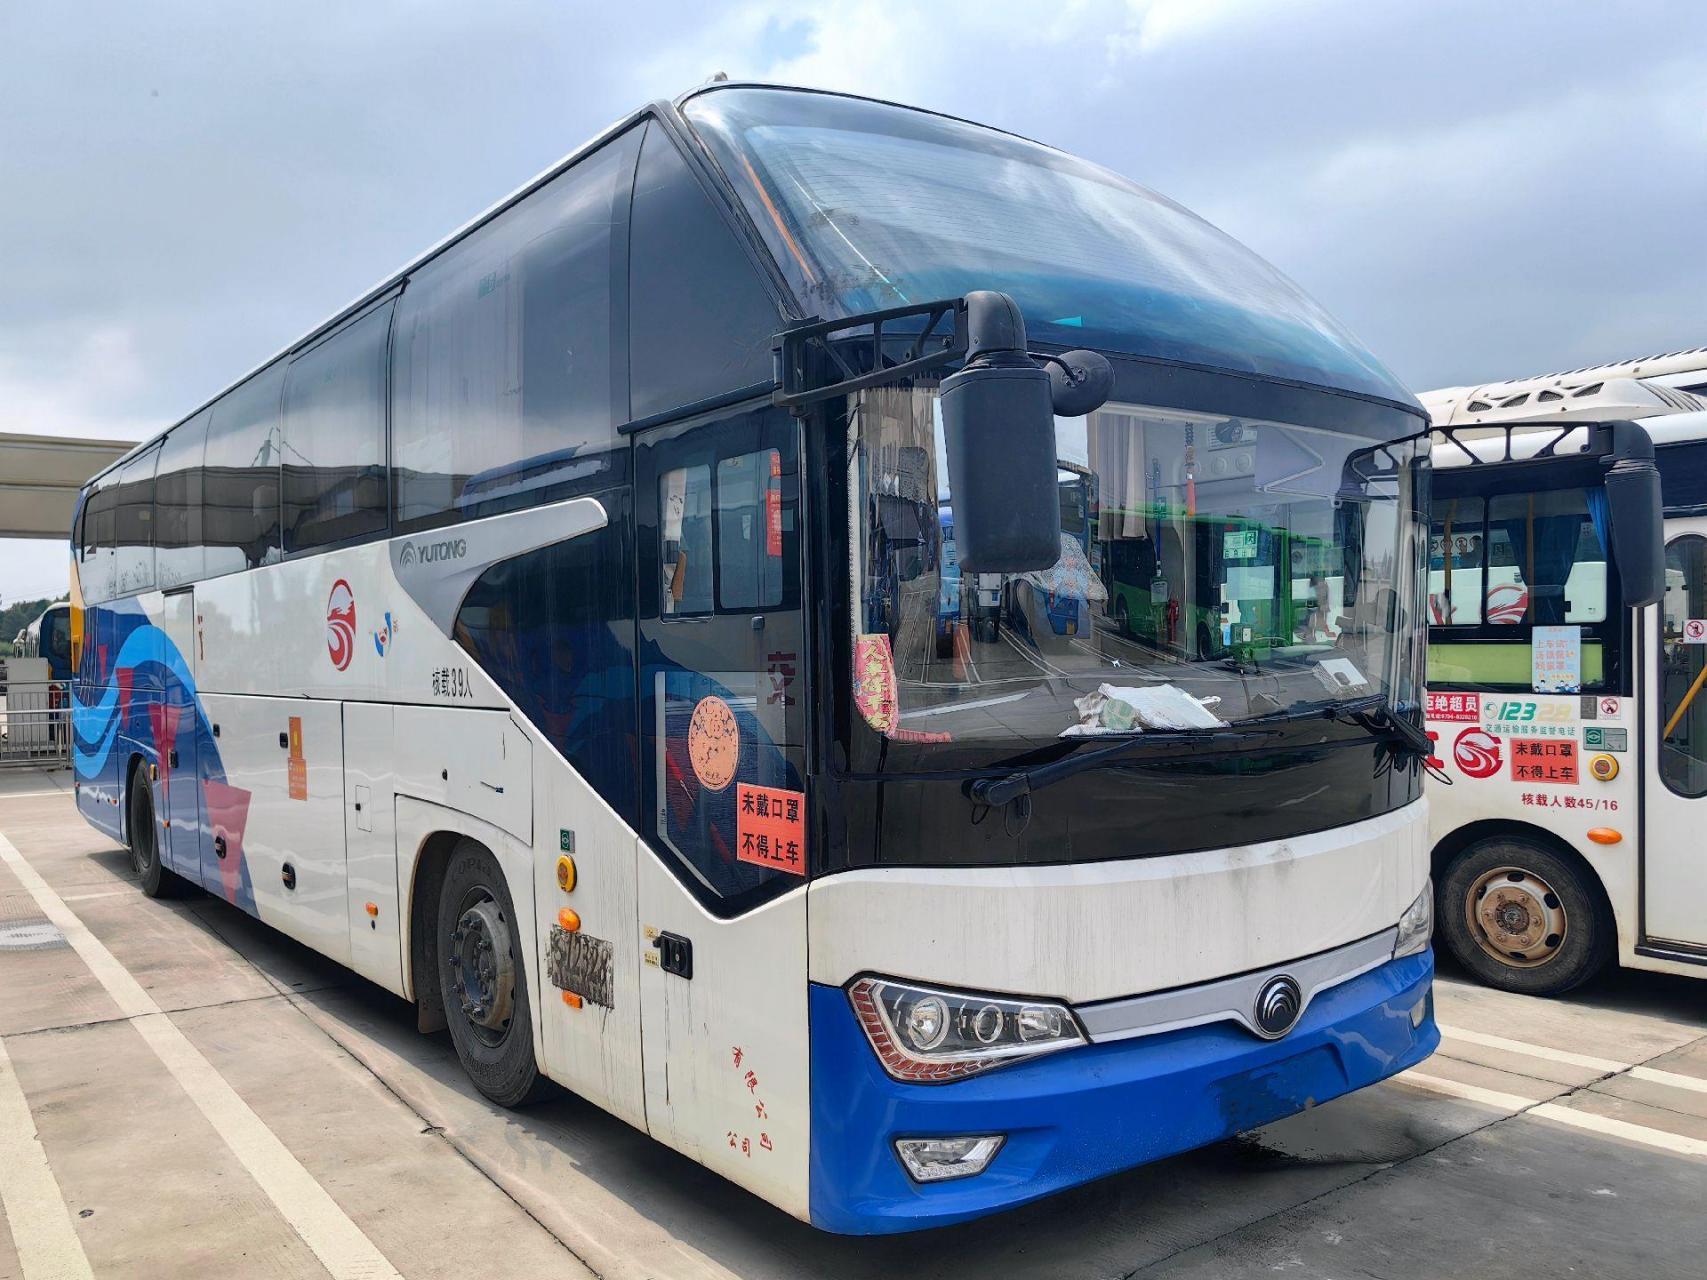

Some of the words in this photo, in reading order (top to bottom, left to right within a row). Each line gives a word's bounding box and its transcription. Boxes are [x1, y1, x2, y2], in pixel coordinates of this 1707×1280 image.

[418, 539, 467, 563] YUTONG
[432, 667, 473, 698] 核载39人
[1516, 742, 1573, 757] 未戴口罩
[1517, 765, 1574, 779] 不得上车
[742, 792, 799, 823] 未戴口罩
[1521, 793, 1618, 811] 核载人数45/16
[742, 832, 799, 865] 不得上车
